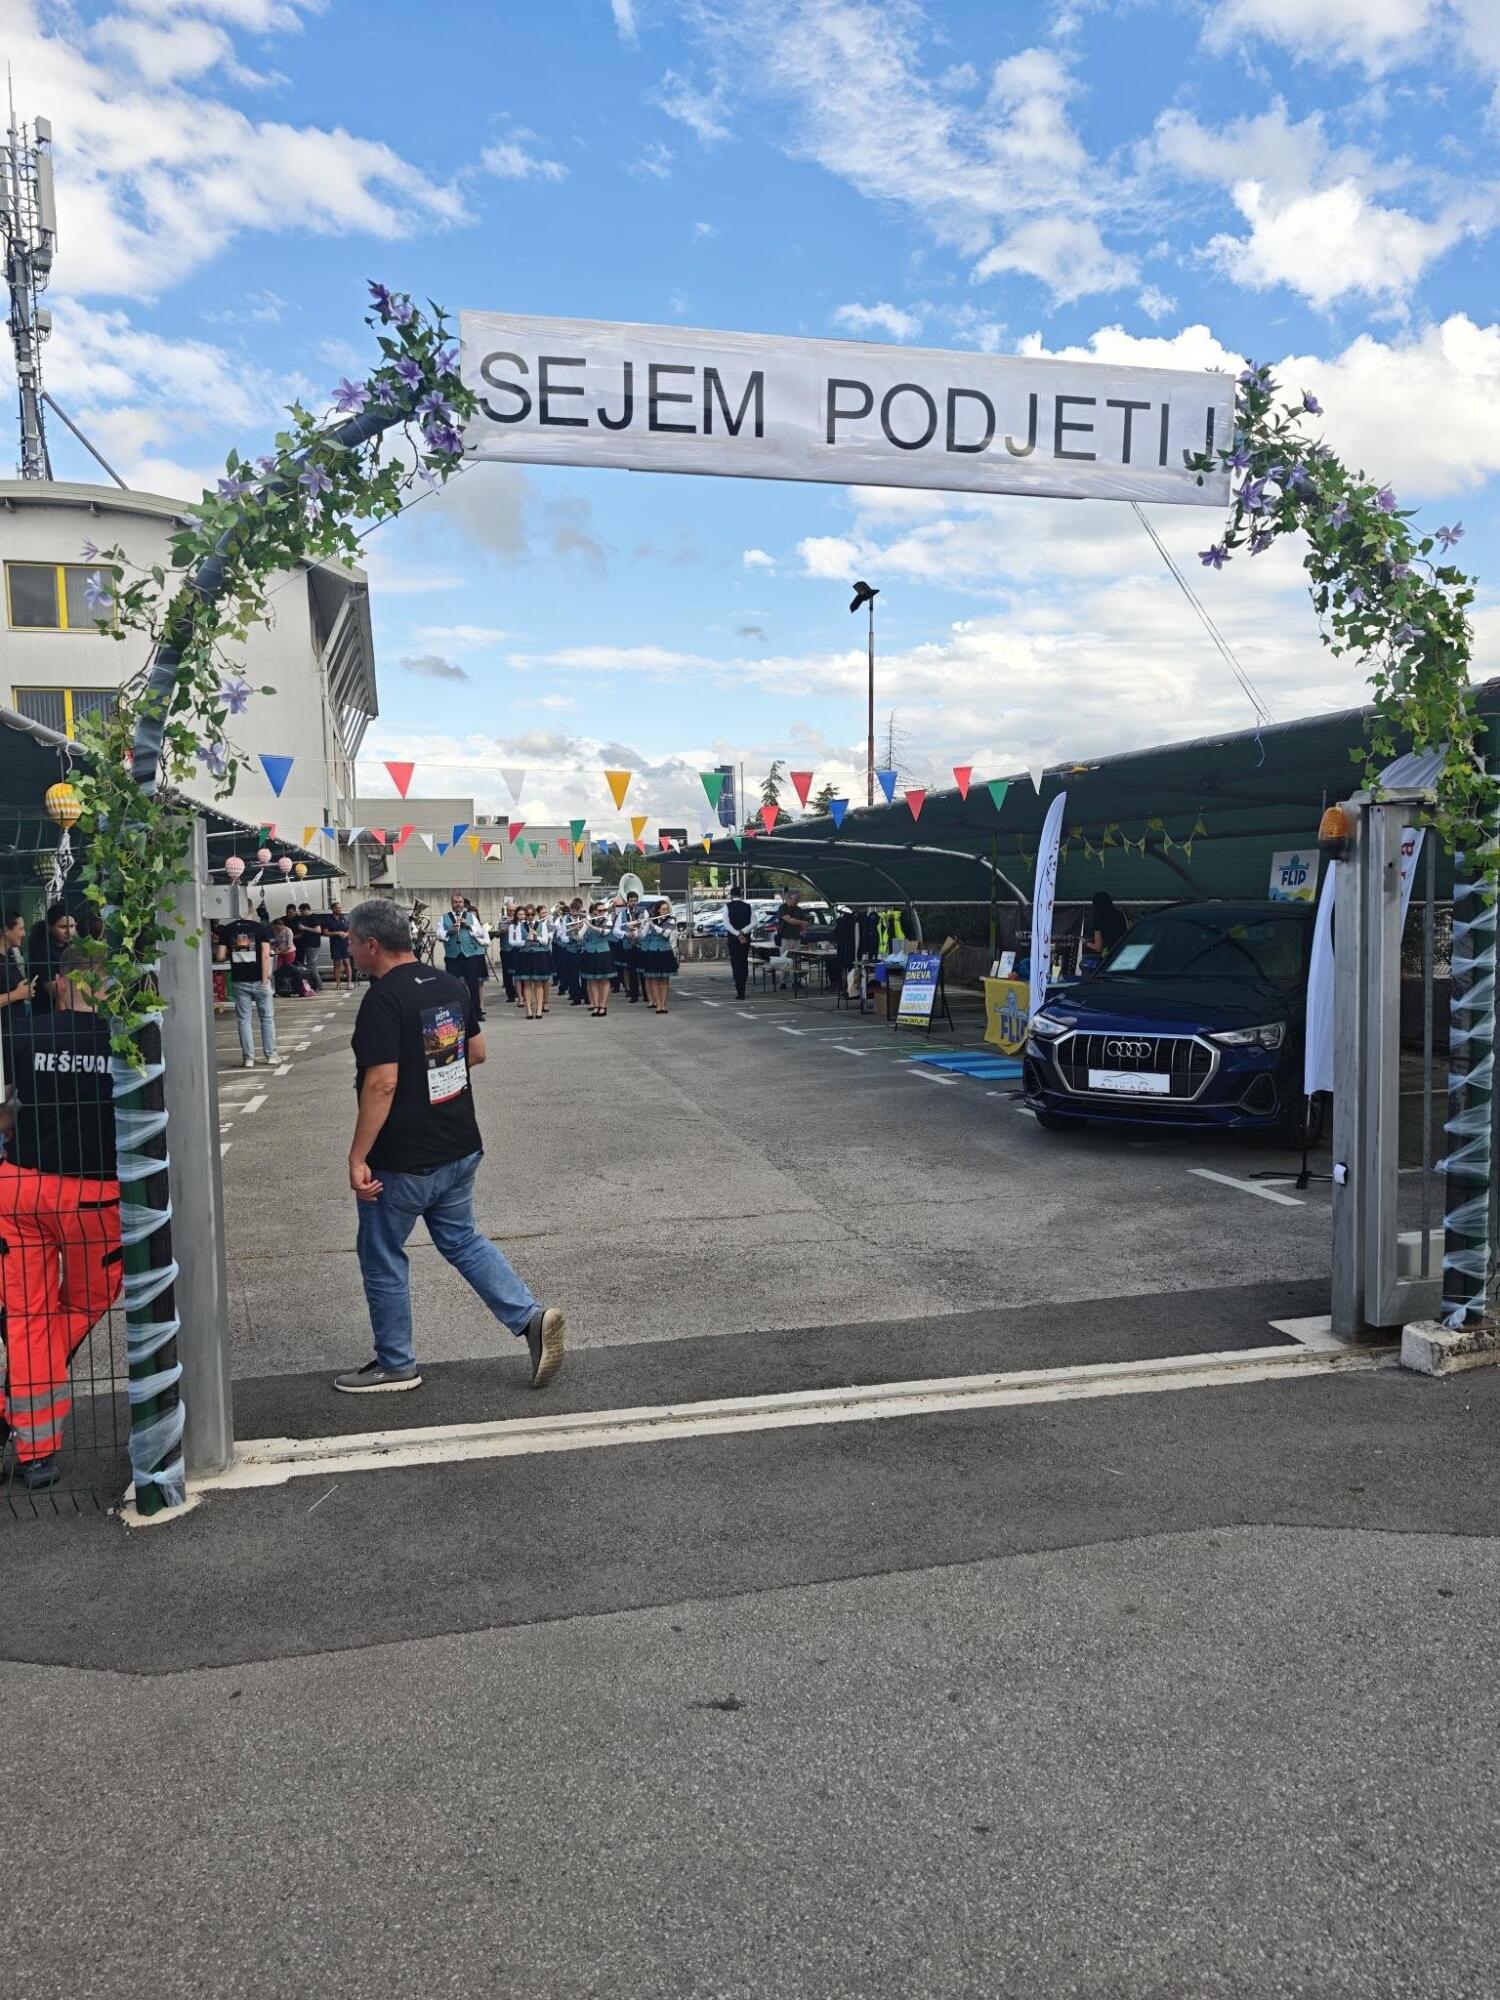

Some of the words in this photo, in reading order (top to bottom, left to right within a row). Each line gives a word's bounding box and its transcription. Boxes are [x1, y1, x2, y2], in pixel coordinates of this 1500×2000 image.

[479, 351, 764, 438] SEJEM
[826, 378, 1215, 467] PODJETIJ
[1281, 869, 1307, 886] FLIP
[909, 961, 928, 970] IZZIV
[906, 970, 930, 980] DNEVA
